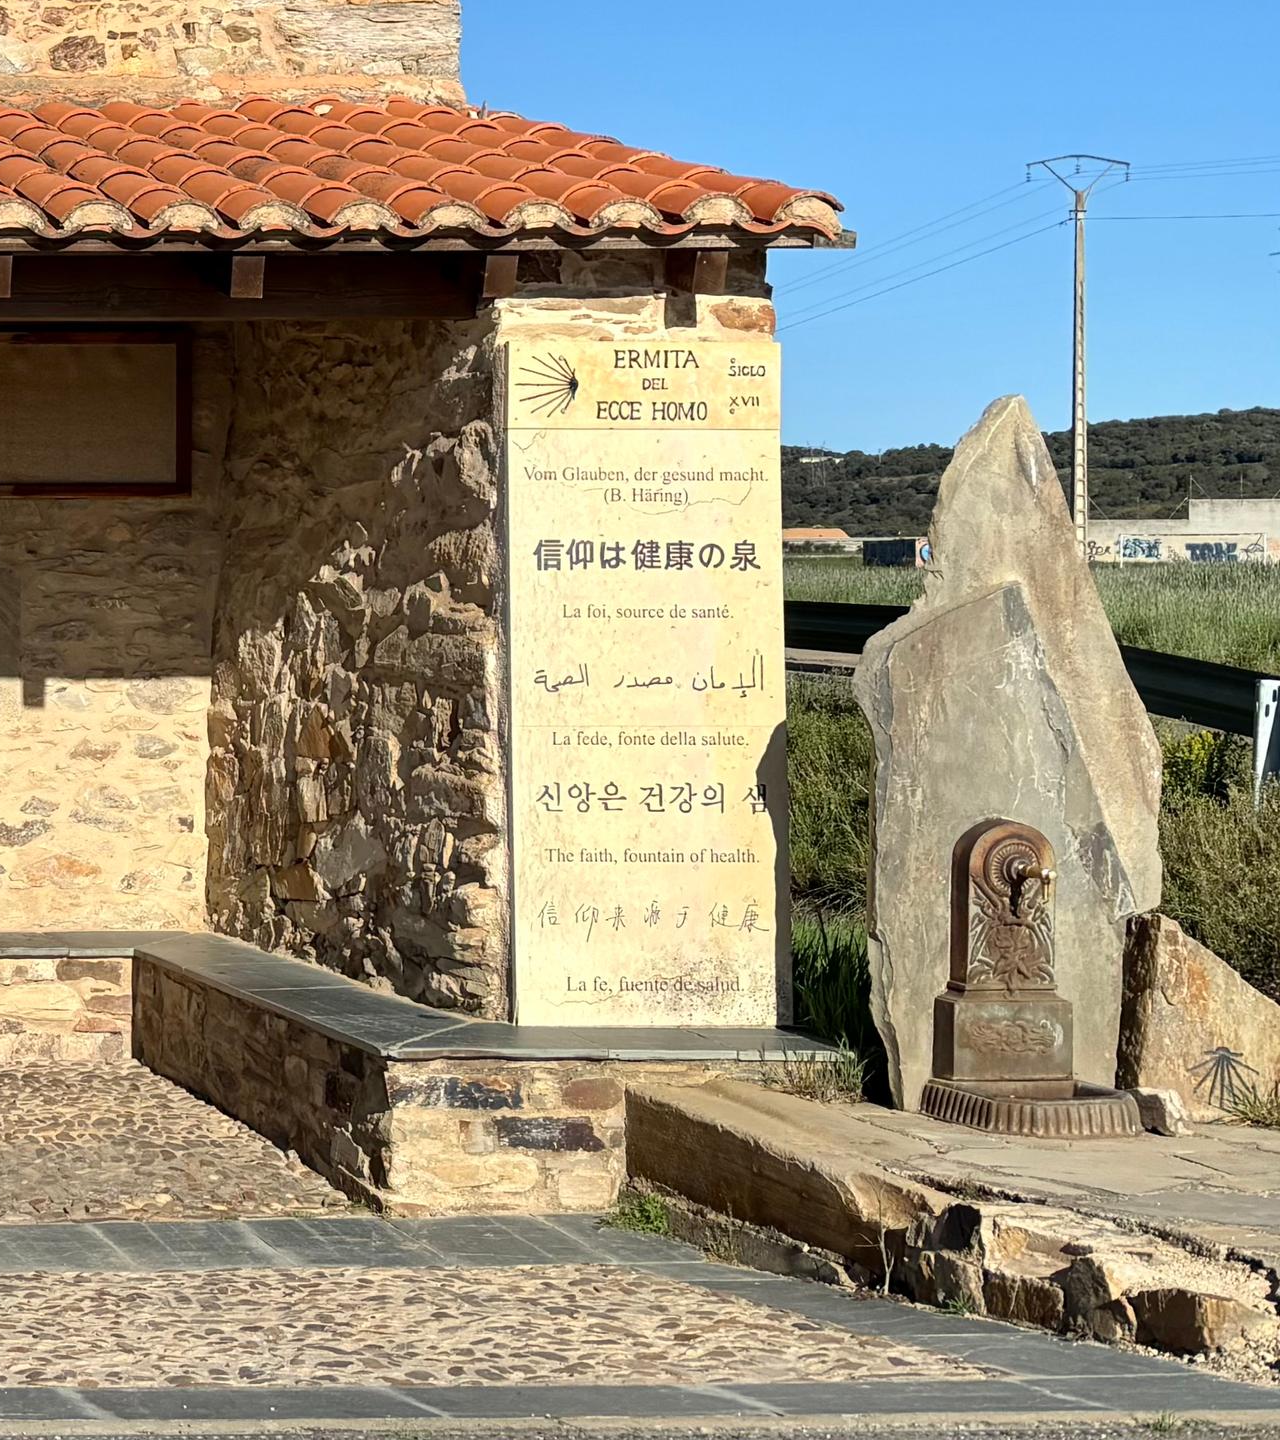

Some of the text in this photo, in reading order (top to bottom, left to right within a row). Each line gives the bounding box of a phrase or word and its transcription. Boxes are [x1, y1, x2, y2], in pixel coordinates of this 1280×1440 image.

[613, 349, 700, 369] ERMITA
[728, 365, 766, 377] SIGLO
[642, 378, 669, 390] DEL
[596, 400, 708, 421] ECCE HOMO
[524, 466, 769, 484] Vom Glauben, der gesund macht.
[603, 487, 689, 506] (B. Häring)
[533, 539, 761, 572] 信仰は健康の泉
[562, 603, 734, 621] La foi, source de santé.
[552, 731, 750, 748] La fede, fonte della salute.
[536, 781, 768, 815] 신앙은 건강의 샘
[544, 847, 760, 865] The faith, fountain of health.
[567, 976, 744, 994] La fe, fuente de salud.
